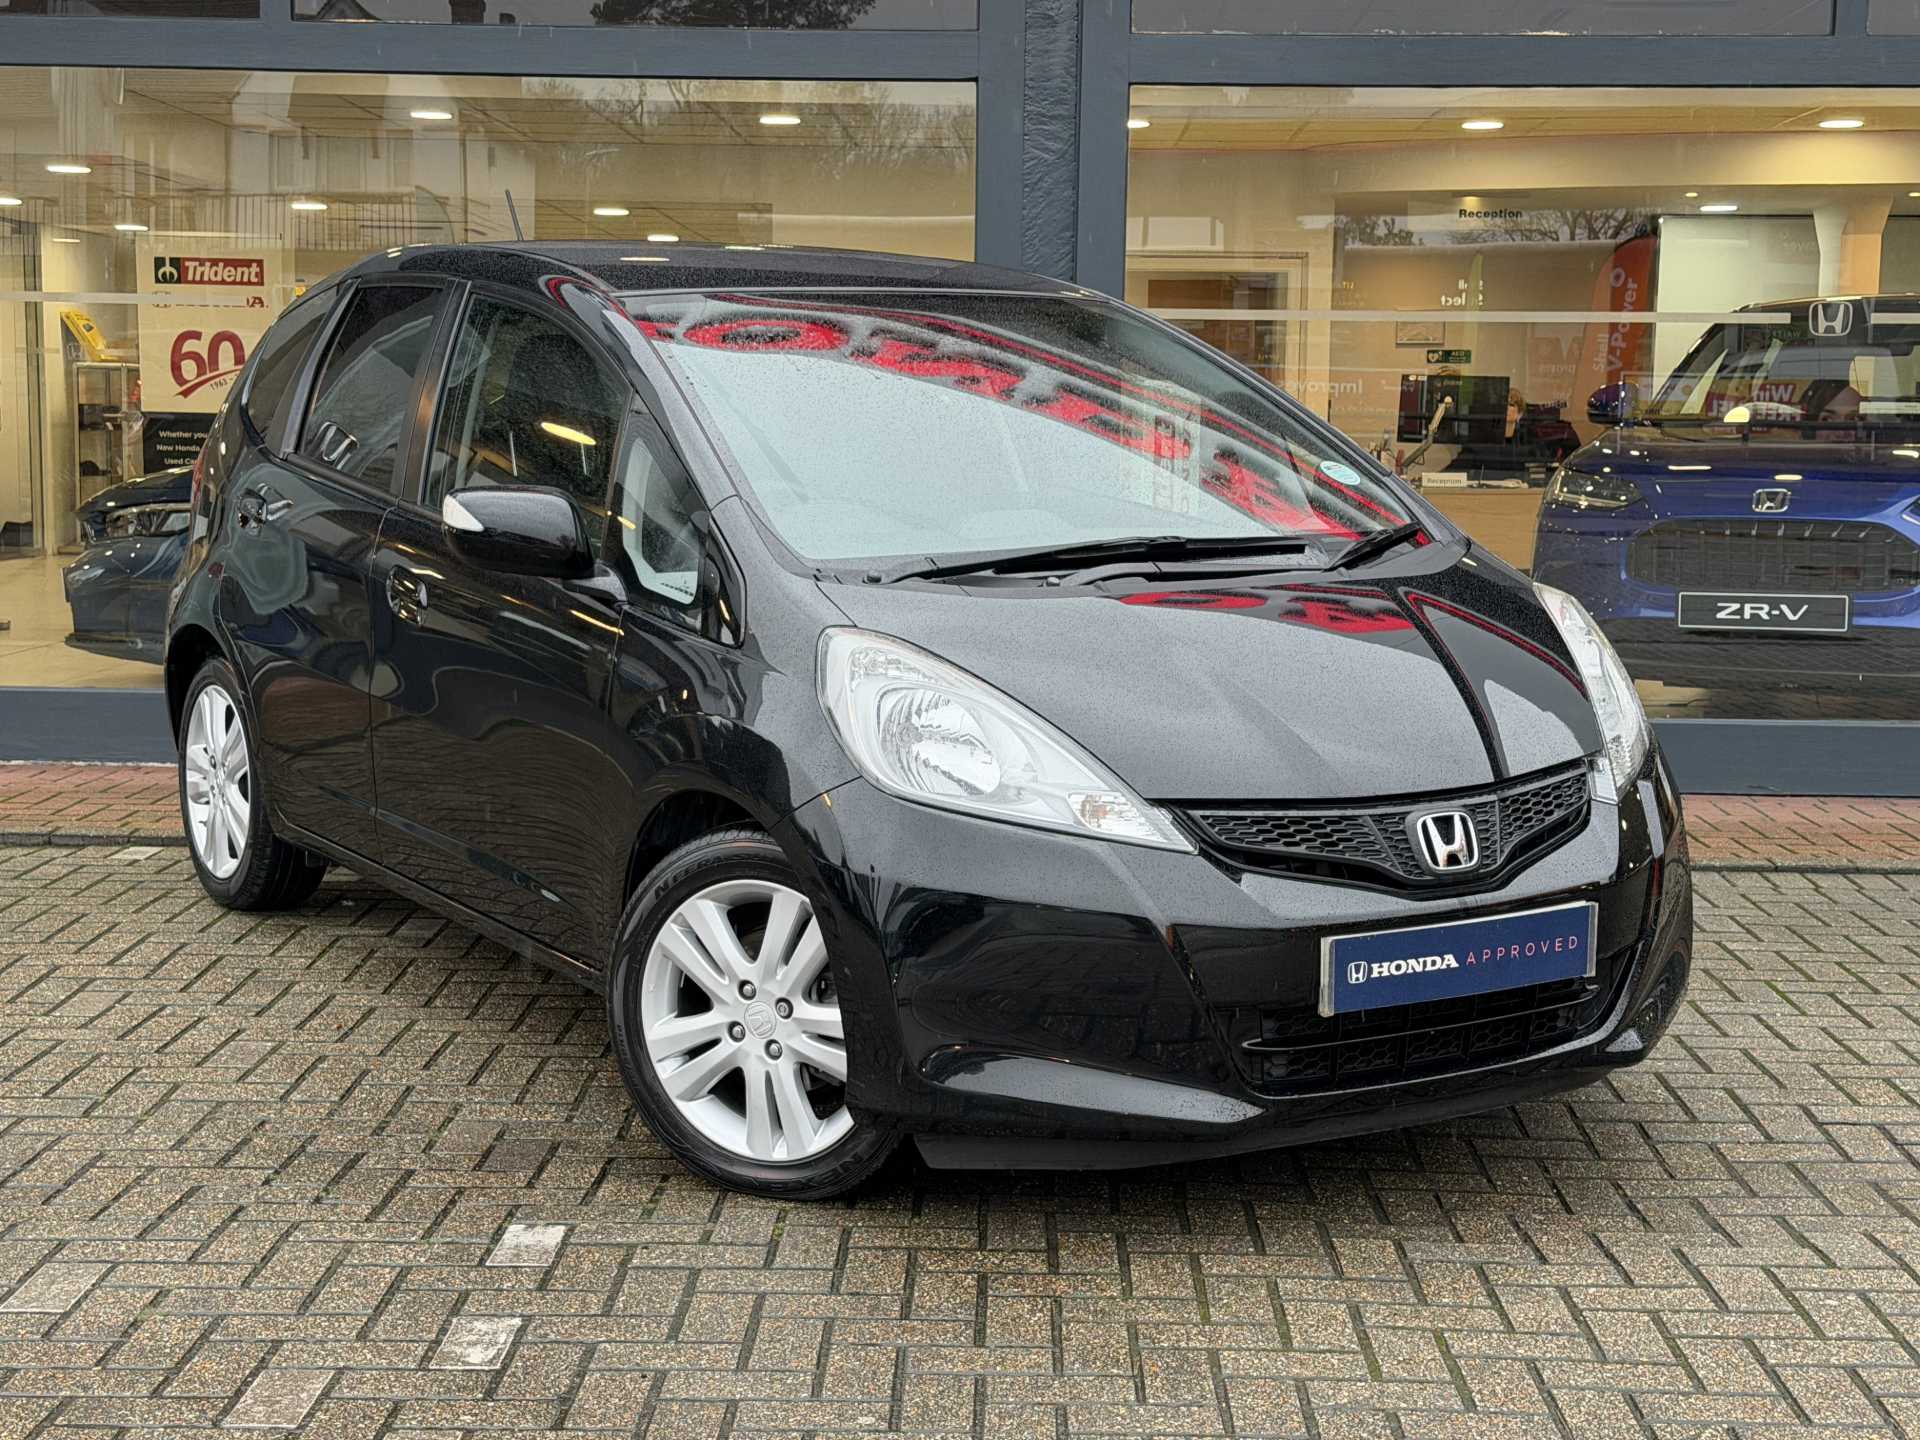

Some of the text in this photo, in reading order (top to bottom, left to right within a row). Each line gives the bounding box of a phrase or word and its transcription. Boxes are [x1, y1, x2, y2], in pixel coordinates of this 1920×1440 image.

[1458, 208, 1523, 219] Reception
[184, 261, 260, 283] Trident
[169, 329, 246, 388] 60
[159, 430, 193, 439] Whether
[156, 443, 174, 452] New
[164, 457, 184, 465] Used
[1715, 602, 1809, 621] ZR-V
[1370, 953, 1460, 978] HONDA
[1466, 935, 1579, 966] APPROVED
